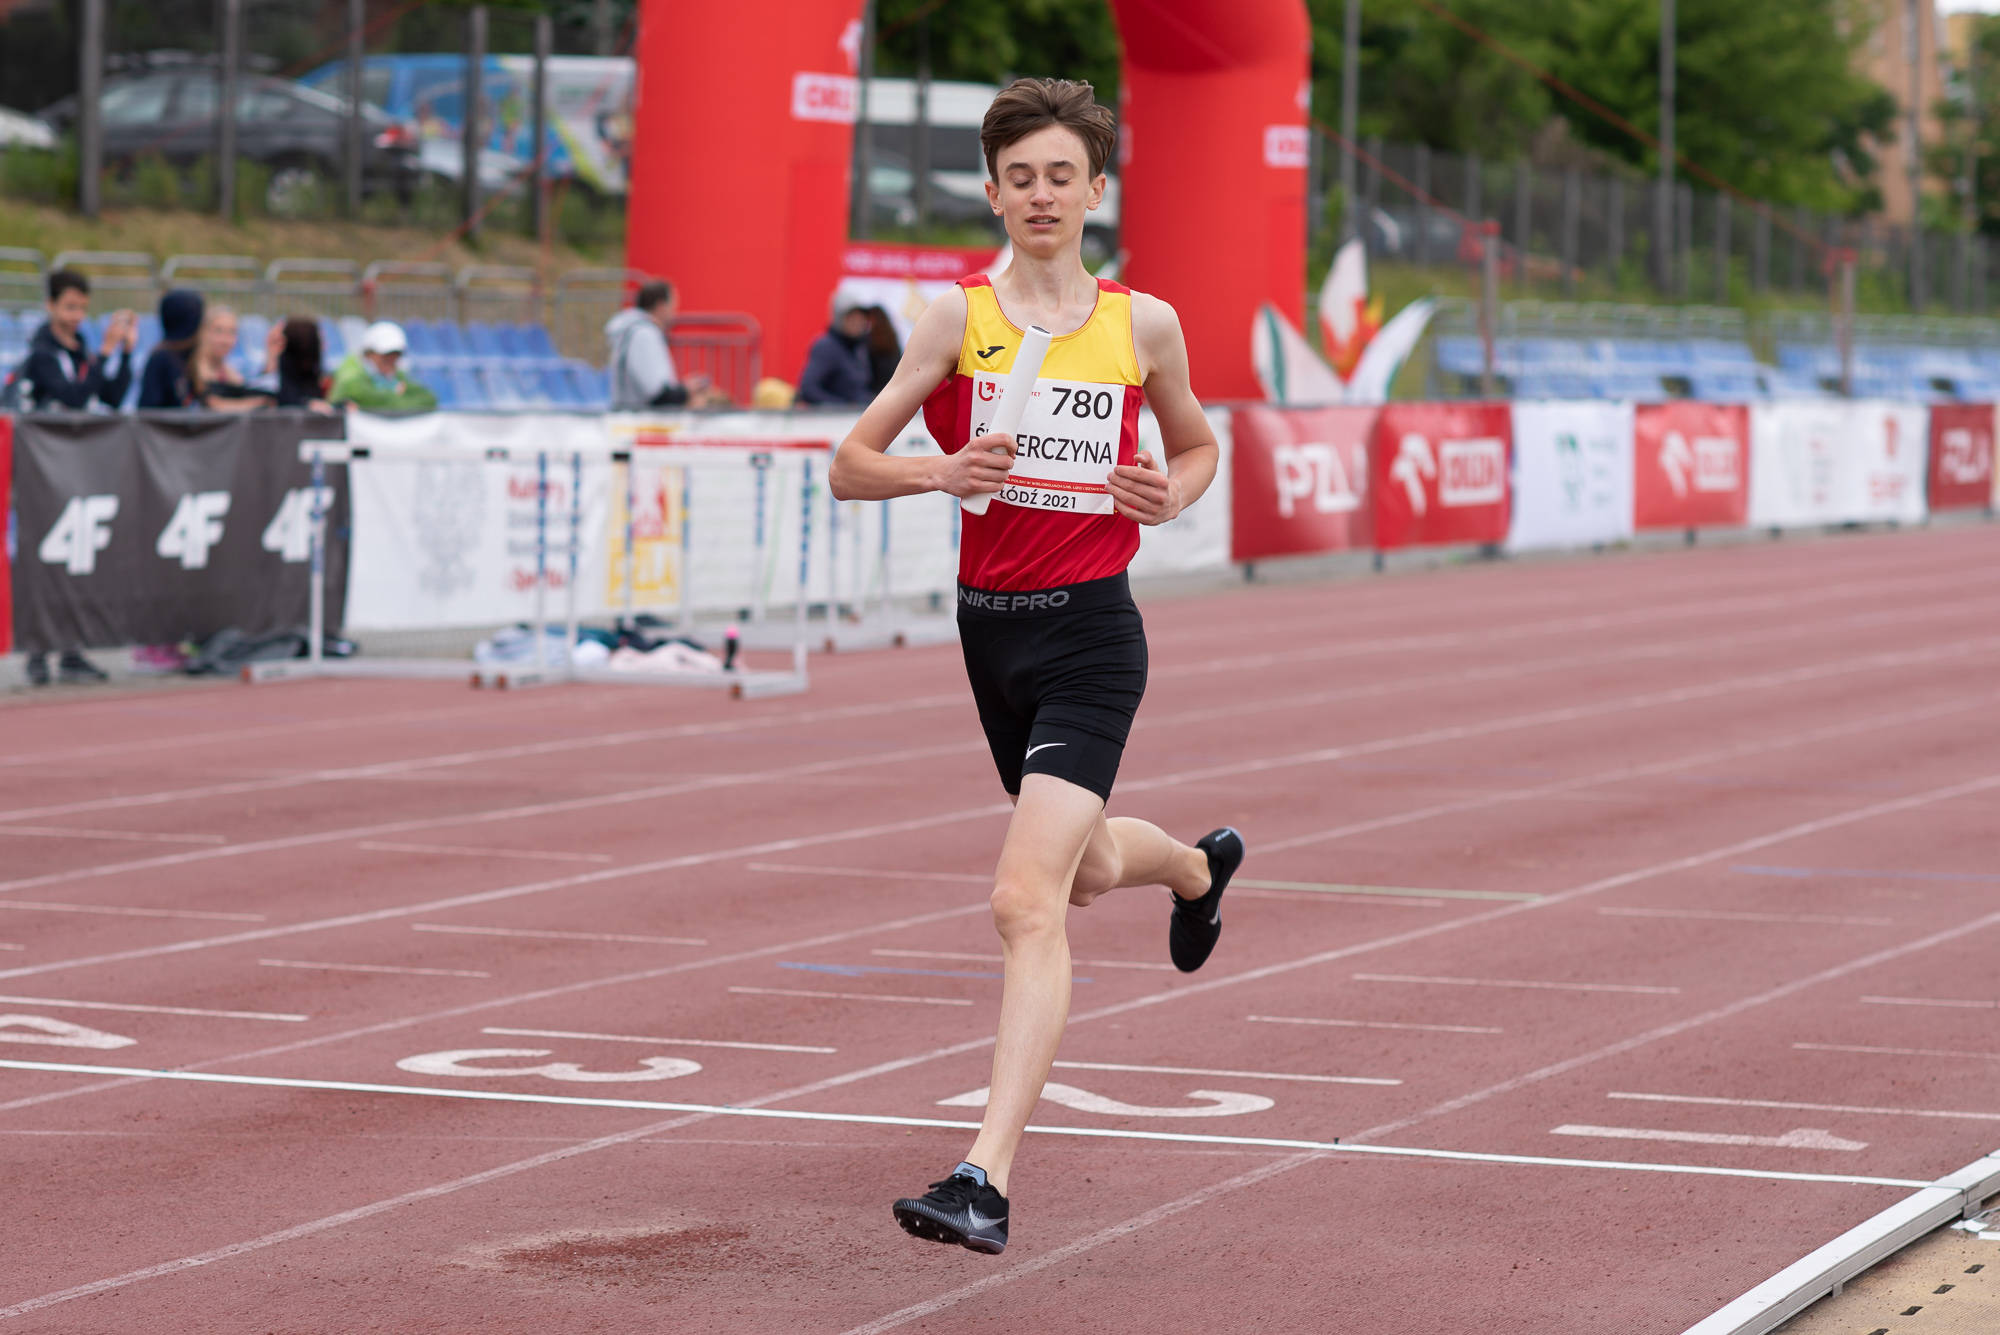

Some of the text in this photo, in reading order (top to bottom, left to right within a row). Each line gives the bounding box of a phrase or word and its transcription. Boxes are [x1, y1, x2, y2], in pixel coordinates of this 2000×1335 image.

[1051, 387, 1113, 420] 780
[975, 422, 1113, 465] ŚERCZYNA
[1000, 486, 1077, 509] ŁÓDŹ 2021
[38, 495, 119, 575] 4F
[157, 491, 231, 569] 4F
[262, 487, 335, 563] 4F
[959, 587, 1069, 611] NIKE PRO
[395, 1048, 702, 1083] 3
[935, 1082, 1275, 1117] 2
[1549, 1124, 1869, 1151] 1
